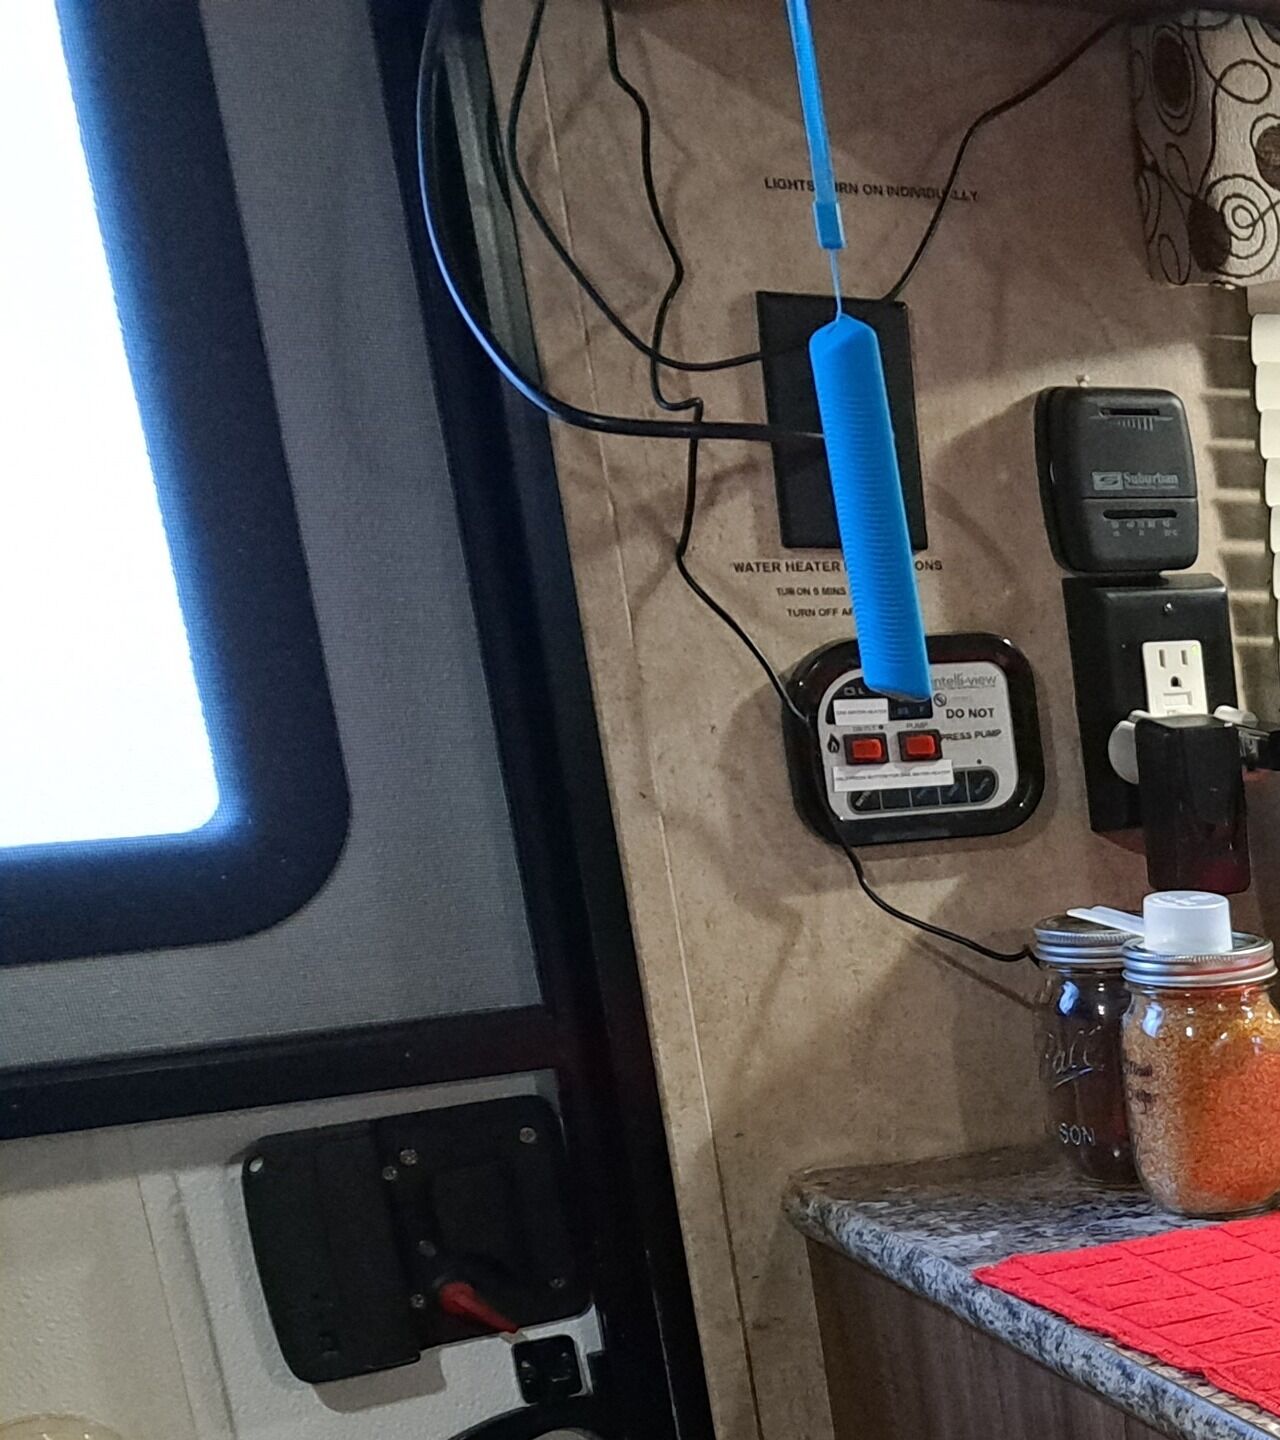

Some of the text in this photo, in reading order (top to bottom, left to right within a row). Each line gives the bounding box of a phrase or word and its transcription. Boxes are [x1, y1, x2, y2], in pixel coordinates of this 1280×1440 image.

[765, 178, 978, 201] LIGHTS RN ON INDIVIDULLY
[1124, 472, 1178, 485] Suburban
[734, 561, 840, 572] WATER HEATER
[788, 608, 815, 617] TURN
[818, 608, 838, 617] OFF
[933, 672, 997, 686] ntelli-view
[947, 708, 994, 718] DO NOT
[942, 729, 1001, 740] PRESS PUMP
[1059, 1122, 1095, 1146] SON
